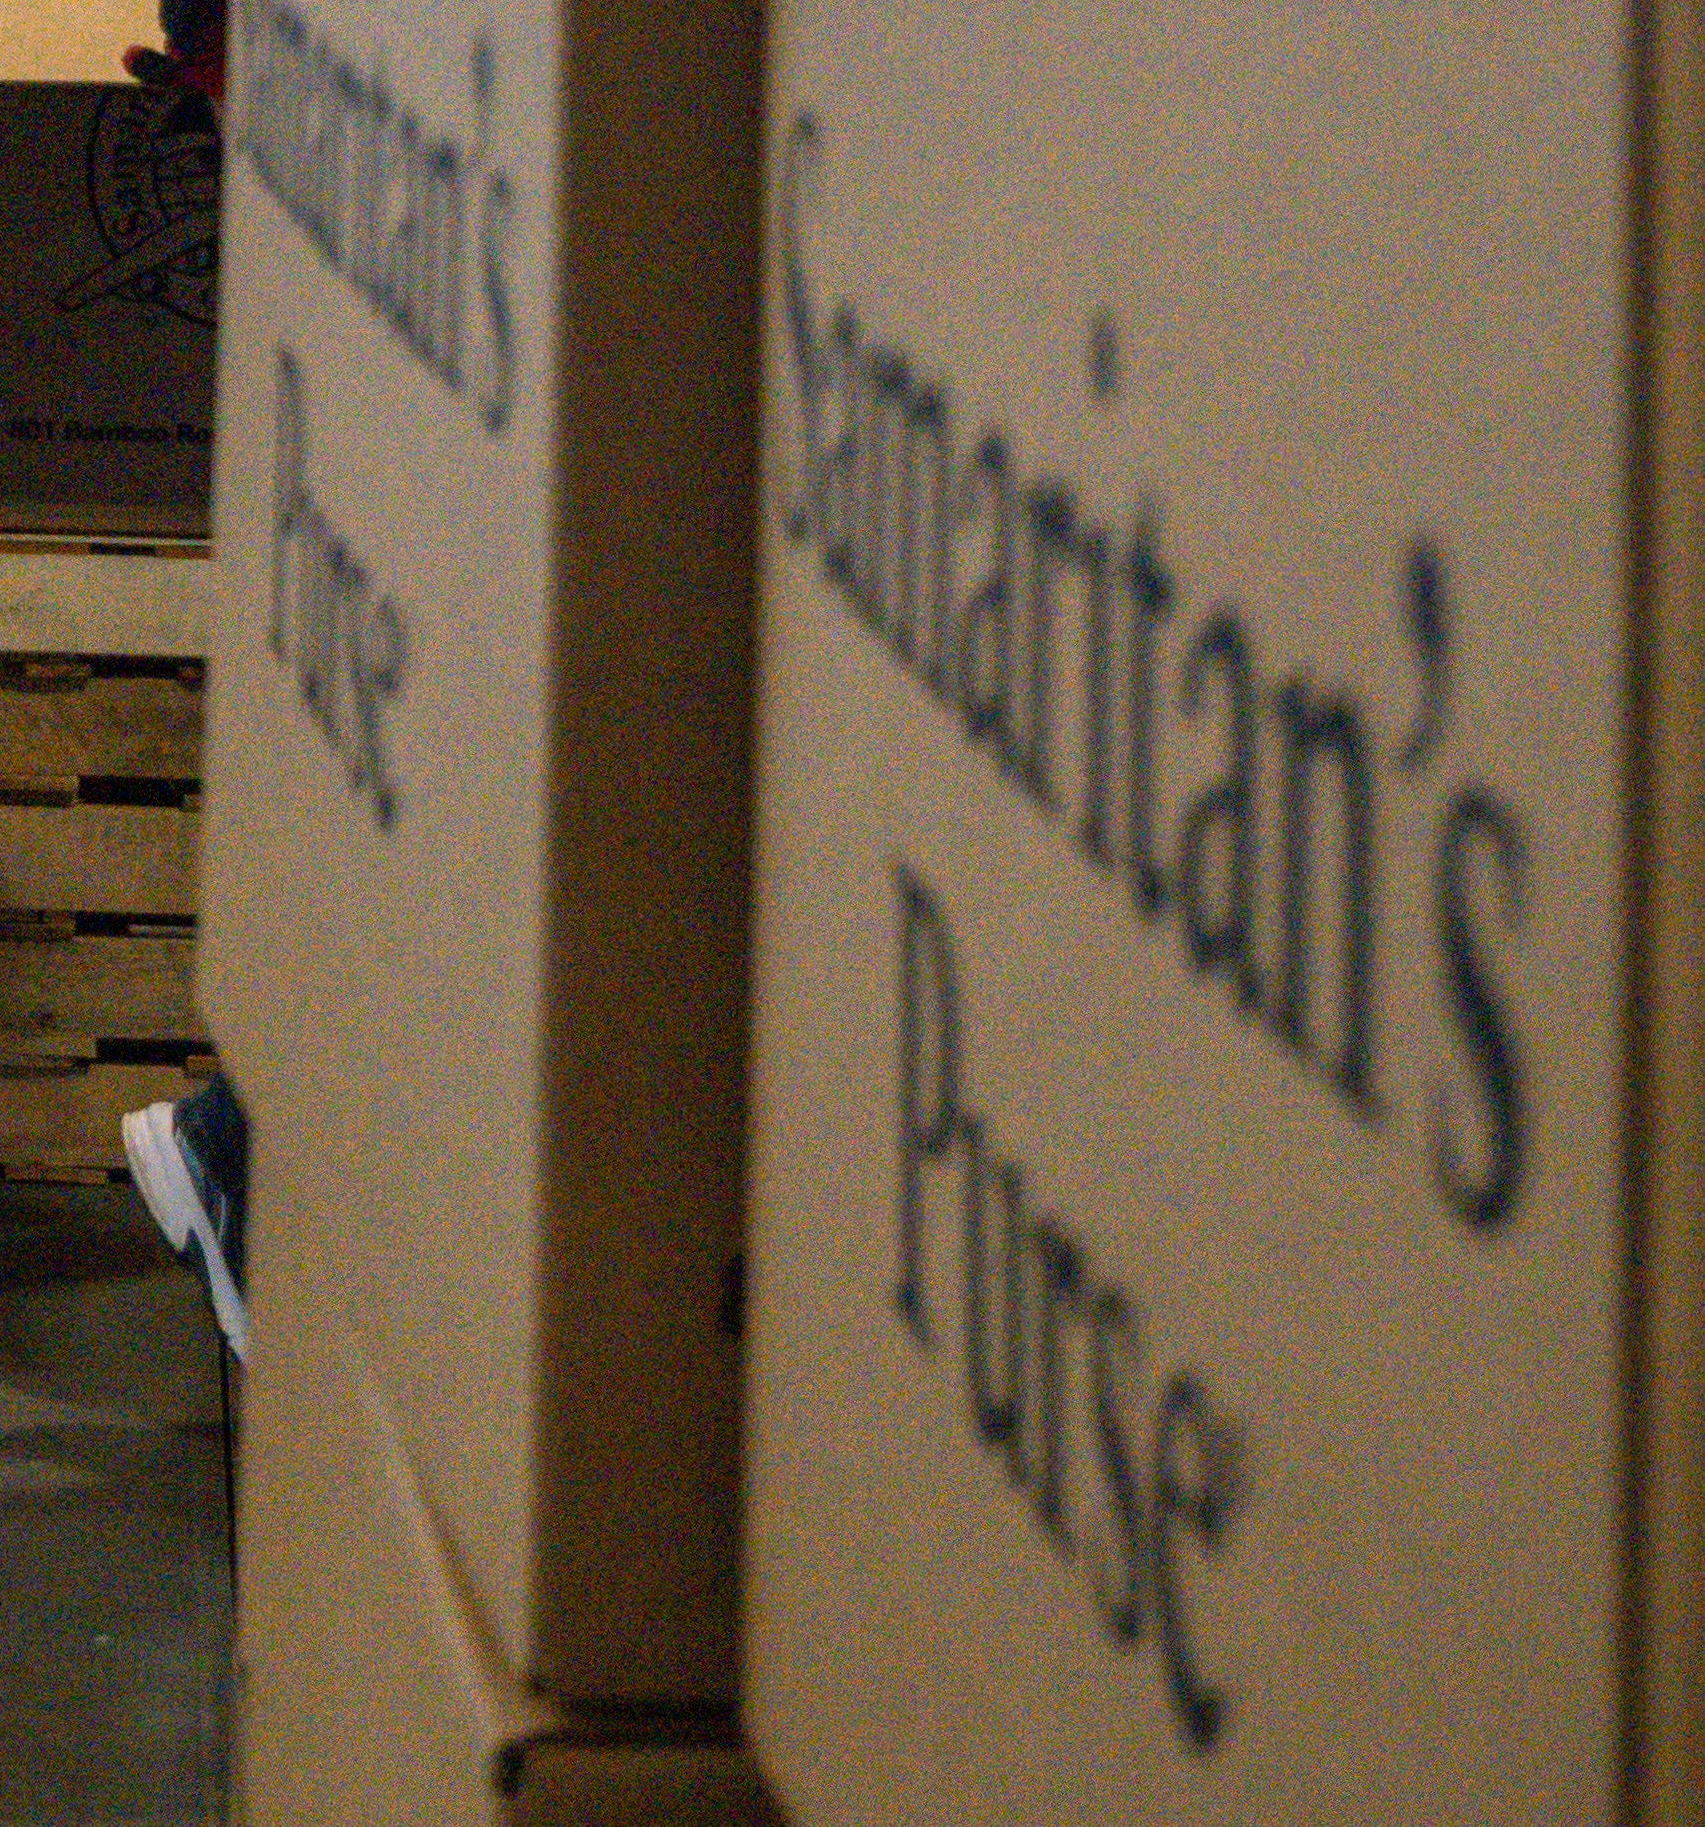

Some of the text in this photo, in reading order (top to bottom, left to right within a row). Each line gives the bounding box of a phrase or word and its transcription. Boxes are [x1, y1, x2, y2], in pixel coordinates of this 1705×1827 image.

[271, 340, 407, 834] Purse
[781, 110, 1531, 1244] Samaritan's
[894, 860, 1249, 1756] Purse
